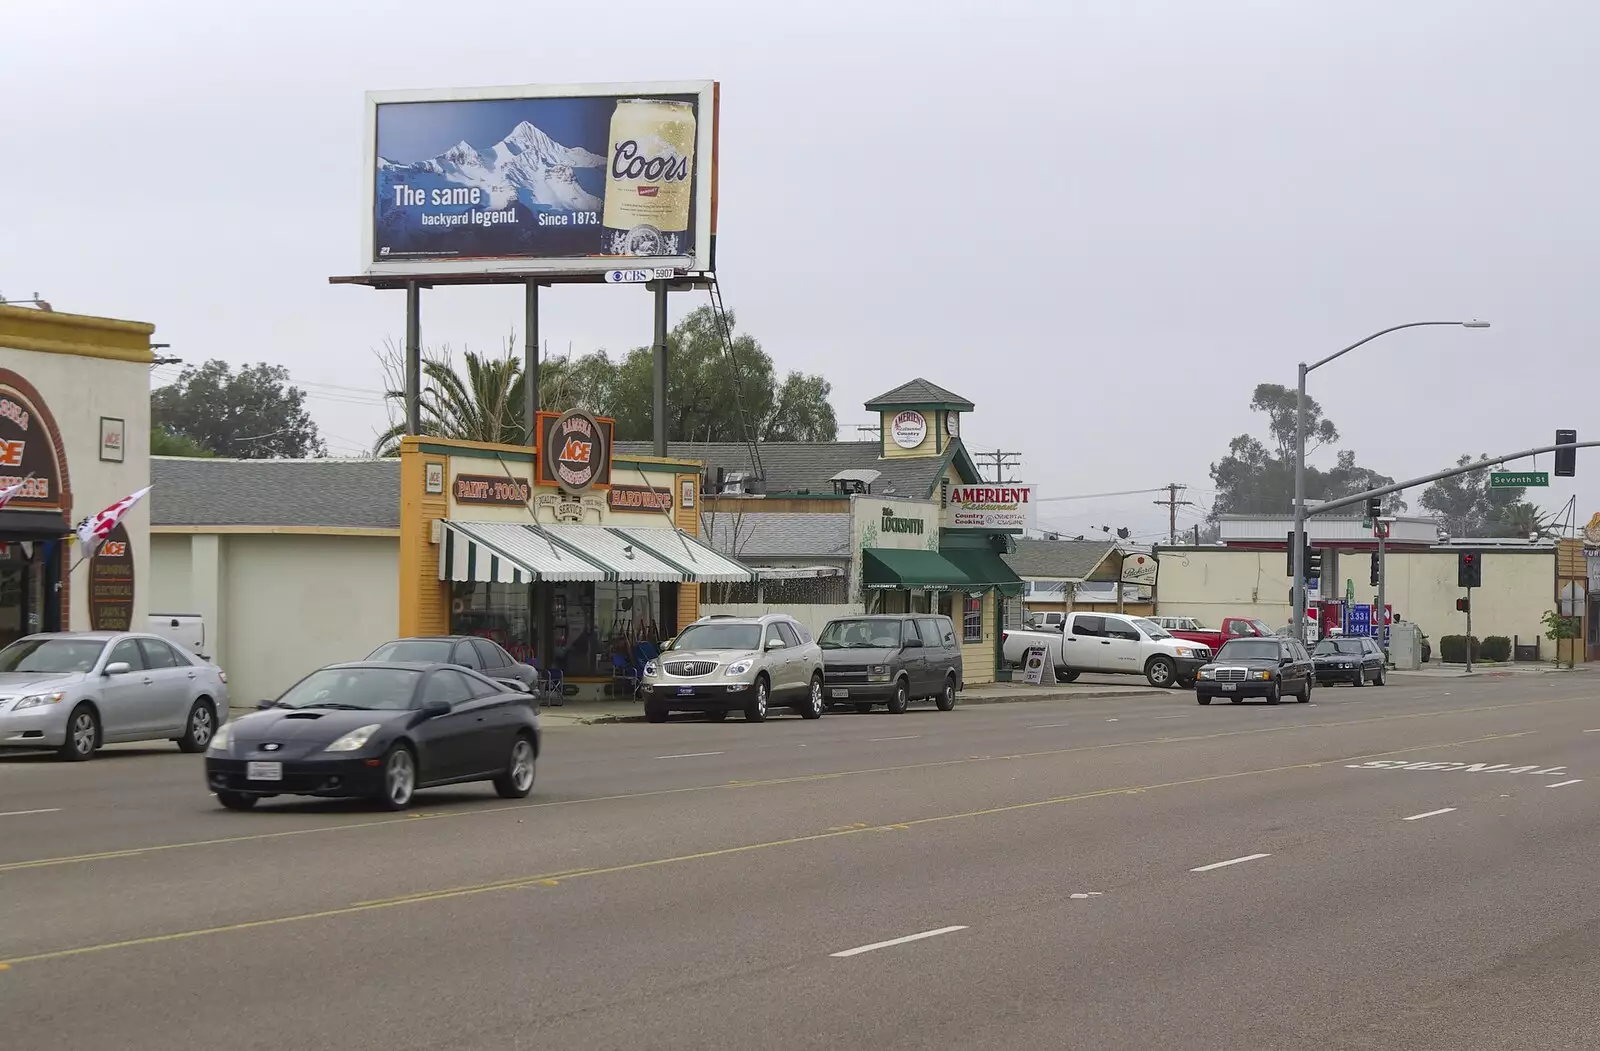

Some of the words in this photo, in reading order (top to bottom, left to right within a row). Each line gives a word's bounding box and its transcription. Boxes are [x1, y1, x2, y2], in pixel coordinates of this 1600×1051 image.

[612, 140, 687, 181] Coors
[393, 185, 425, 206] The
[431, 187, 481, 205] same
[421, 213, 469, 227] backyard
[471, 208, 519, 227] legend.
[538, 213, 568, 226] Since
[571, 212, 600, 225] 1873.
[623, 271, 647, 281] CBS
[655, 269, 673, 278] 5907
[895, 411, 923, 429] AMERIENT
[559, 436, 593, 463] ACE
[458, 481, 488, 499] PAINT
[495, 483, 527, 500] TOOLS
[951, 488, 1030, 503] AMERIENT
[961, 500, 1018, 511] Restaurant
[881, 516, 924, 535] LOCKSMITH
[99, 540, 126, 556] ACE
[1345, 760, 1568, 775] SIGNAL
